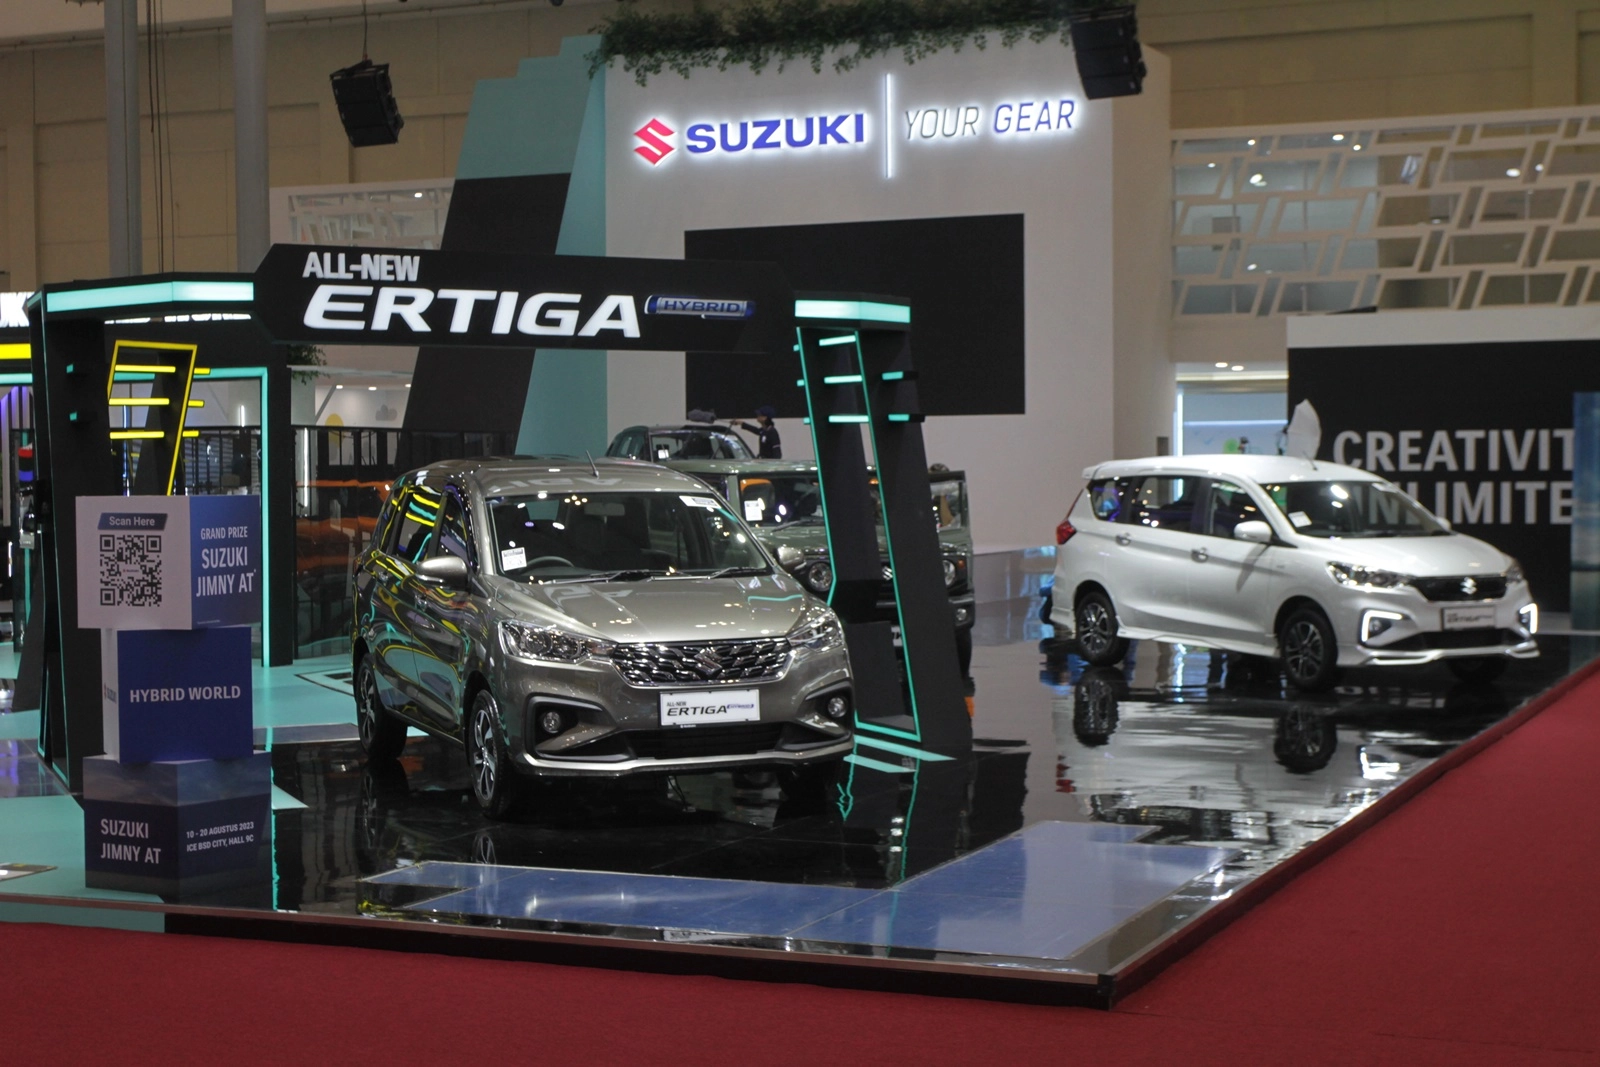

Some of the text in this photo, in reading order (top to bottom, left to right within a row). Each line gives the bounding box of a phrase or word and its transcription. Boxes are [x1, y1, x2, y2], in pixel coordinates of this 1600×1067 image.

[905, 100, 1075, 140] YOUR GEAR
[686, 113, 864, 153] SUZUKI
[302, 251, 420, 281] ALL-NEW
[303, 284, 741, 338] ERTIGA HYBRID
[1319, 480, 1574, 525] NLIMITE
[109, 516, 155, 526] Scan Here
[201, 526, 248, 540] GRAND PRIZE
[202, 546, 248, 569] SUZUKI
[196, 574, 234, 597] JIMNY
[130, 687, 185, 703] HYBRID
[188, 685, 241, 700] WORLD
[667, 705, 728, 716] ERTIGA
[101, 818, 149, 839] SUZUKI
[186, 831, 194, 839] 10
[200, 829, 208, 837] 20
[209, 823, 238, 836] AGUSTUS
[239, 821, 254, 831] 2023
[101, 843, 161, 864] JIMNY AT
[187, 834, 254, 852] ICE BSD CITY, HALL 9C
